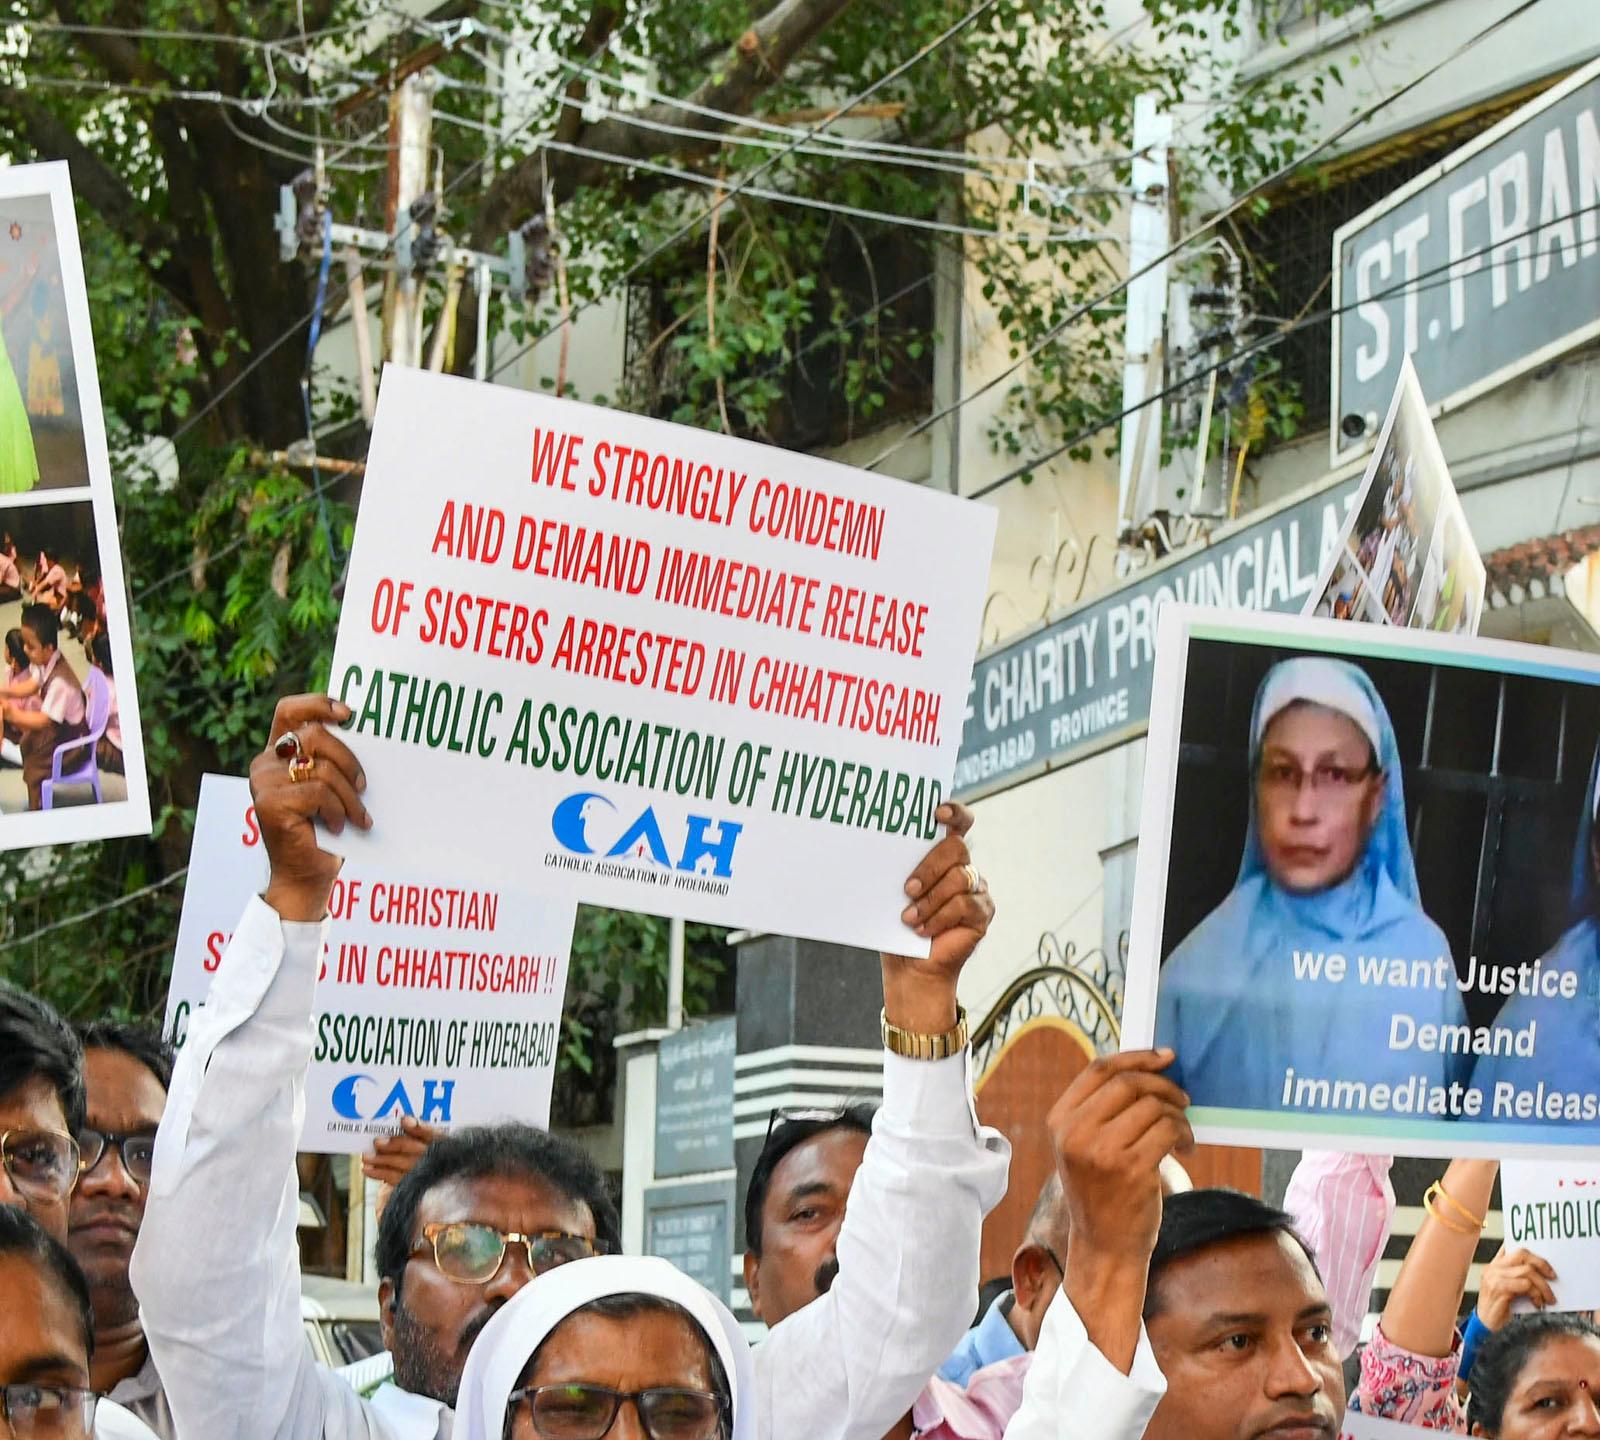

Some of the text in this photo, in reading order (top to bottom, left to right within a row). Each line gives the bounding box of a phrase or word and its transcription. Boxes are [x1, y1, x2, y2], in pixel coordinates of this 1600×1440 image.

[529, 427, 887, 561] WE STRONGLY CONDEMN
[432, 500, 929, 658] AND DEMAND IMMEDIATE RELEASE
[371, 577, 415, 637] OF
[419, 586, 549, 666] SISTERS
[551, 615, 706, 696] ARRESTED
[708, 647, 747, 705] IN
[749, 656, 941, 747] CHHATTISGARH.
[982, 614, 1101, 732] CHARITY
[1050, 688, 1128, 748] PROVINCE
[338, 665, 943, 841] CATHOLIC ASSOCIATION OF HYDERABAD
[551, 792, 744, 878] CAH
[544, 853, 729, 897] CATHOLIC ASSOCIATION OF HYDERABAD
[328, 879, 499, 932] OF CHRISTIAN
[336, 943, 368, 985] IN
[375, 946, 542, 994] CHHATTISGARH
[1357, 952, 1449, 991] want
[1455, 955, 1579, 999] Justice
[311, 1012, 556, 1069] SSOCIATION OF HYDERABAD
[1388, 1013, 1537, 1058] Demand
[331, 1073, 455, 1122] CAH
[1281, 1067, 1483, 1117] immediate
